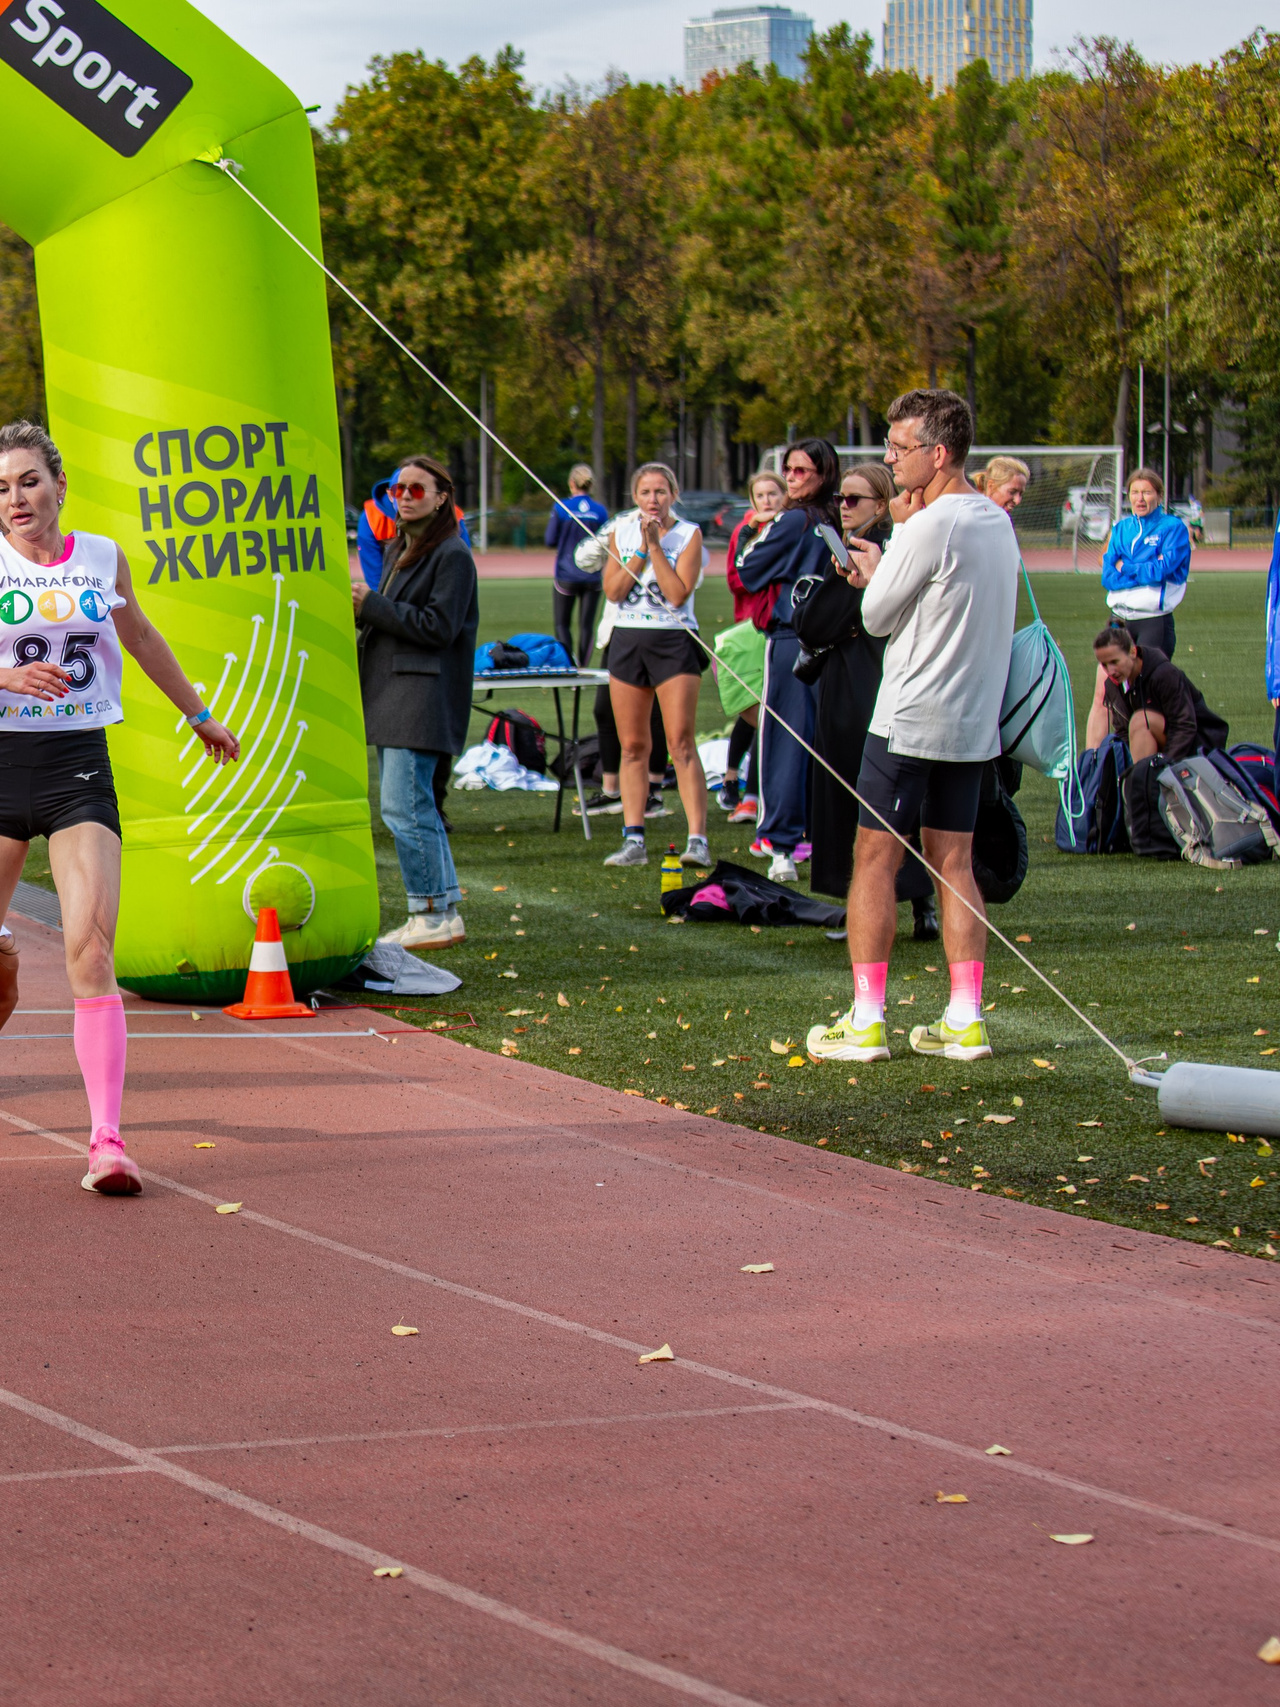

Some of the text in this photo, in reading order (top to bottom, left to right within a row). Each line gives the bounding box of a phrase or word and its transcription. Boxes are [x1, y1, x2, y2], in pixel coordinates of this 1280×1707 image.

[10, 0, 161, 130] Sport
[133, 421, 289, 478] СПОРТ
[138, 474, 321, 533] НОРМА
[144, 526, 326, 586] ЖИЗНИ
[12, 631, 100, 693] 85
